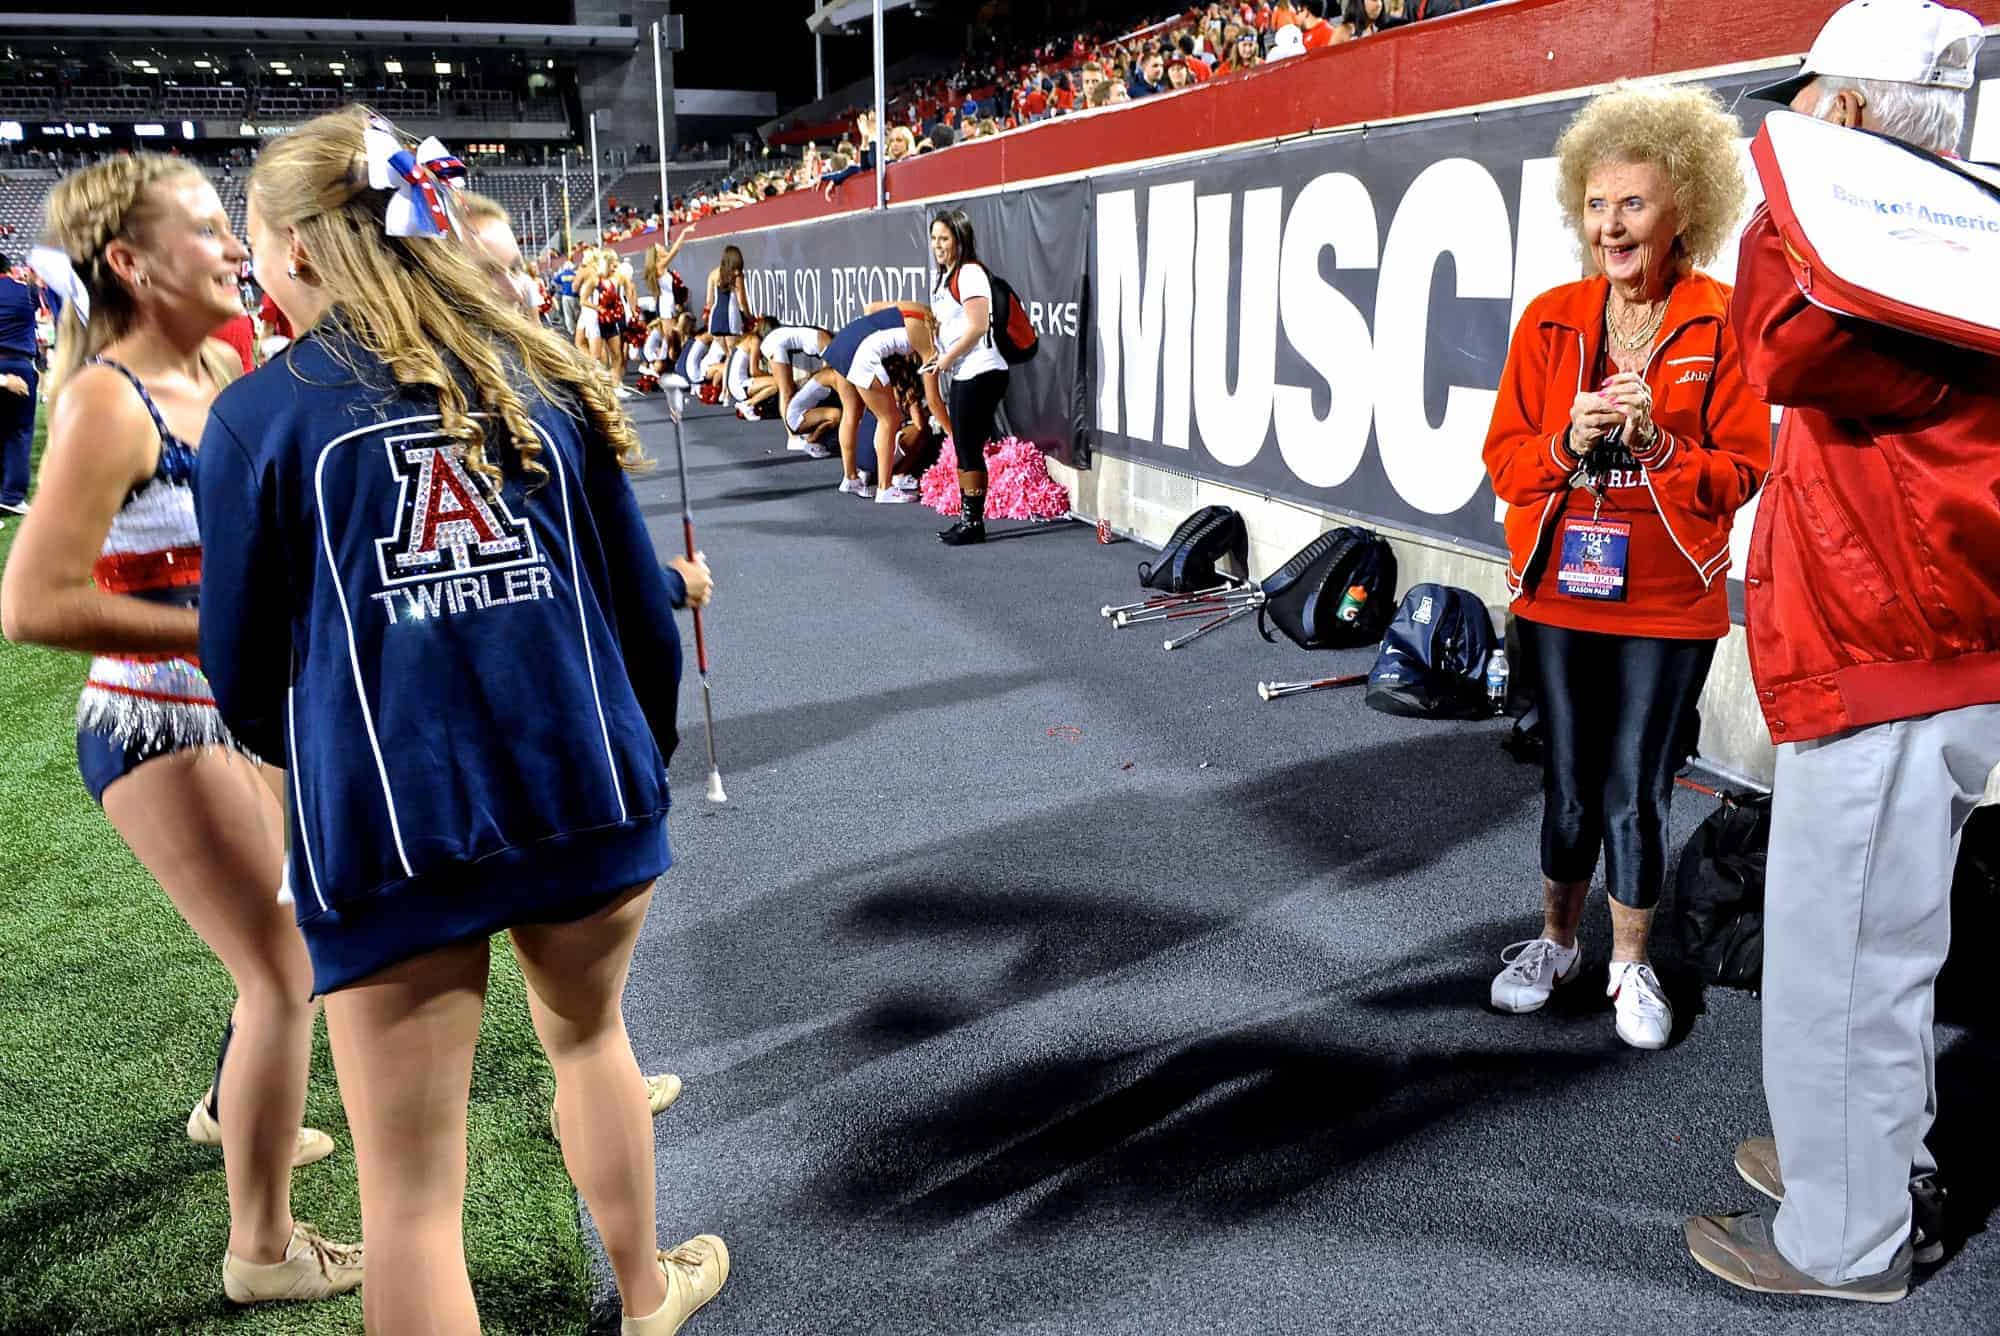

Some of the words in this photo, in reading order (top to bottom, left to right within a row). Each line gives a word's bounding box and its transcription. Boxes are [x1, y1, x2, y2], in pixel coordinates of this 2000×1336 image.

[1832, 183, 1888, 215] Bank
[831, 265, 926, 333] RESORT
[1021, 300, 1079, 337] RKS
[374, 432, 538, 586] A
[1580, 531, 1612, 545] 2014
[370, 566, 555, 625] TWIRLER
[1567, 585, 1594, 594] SEASON
